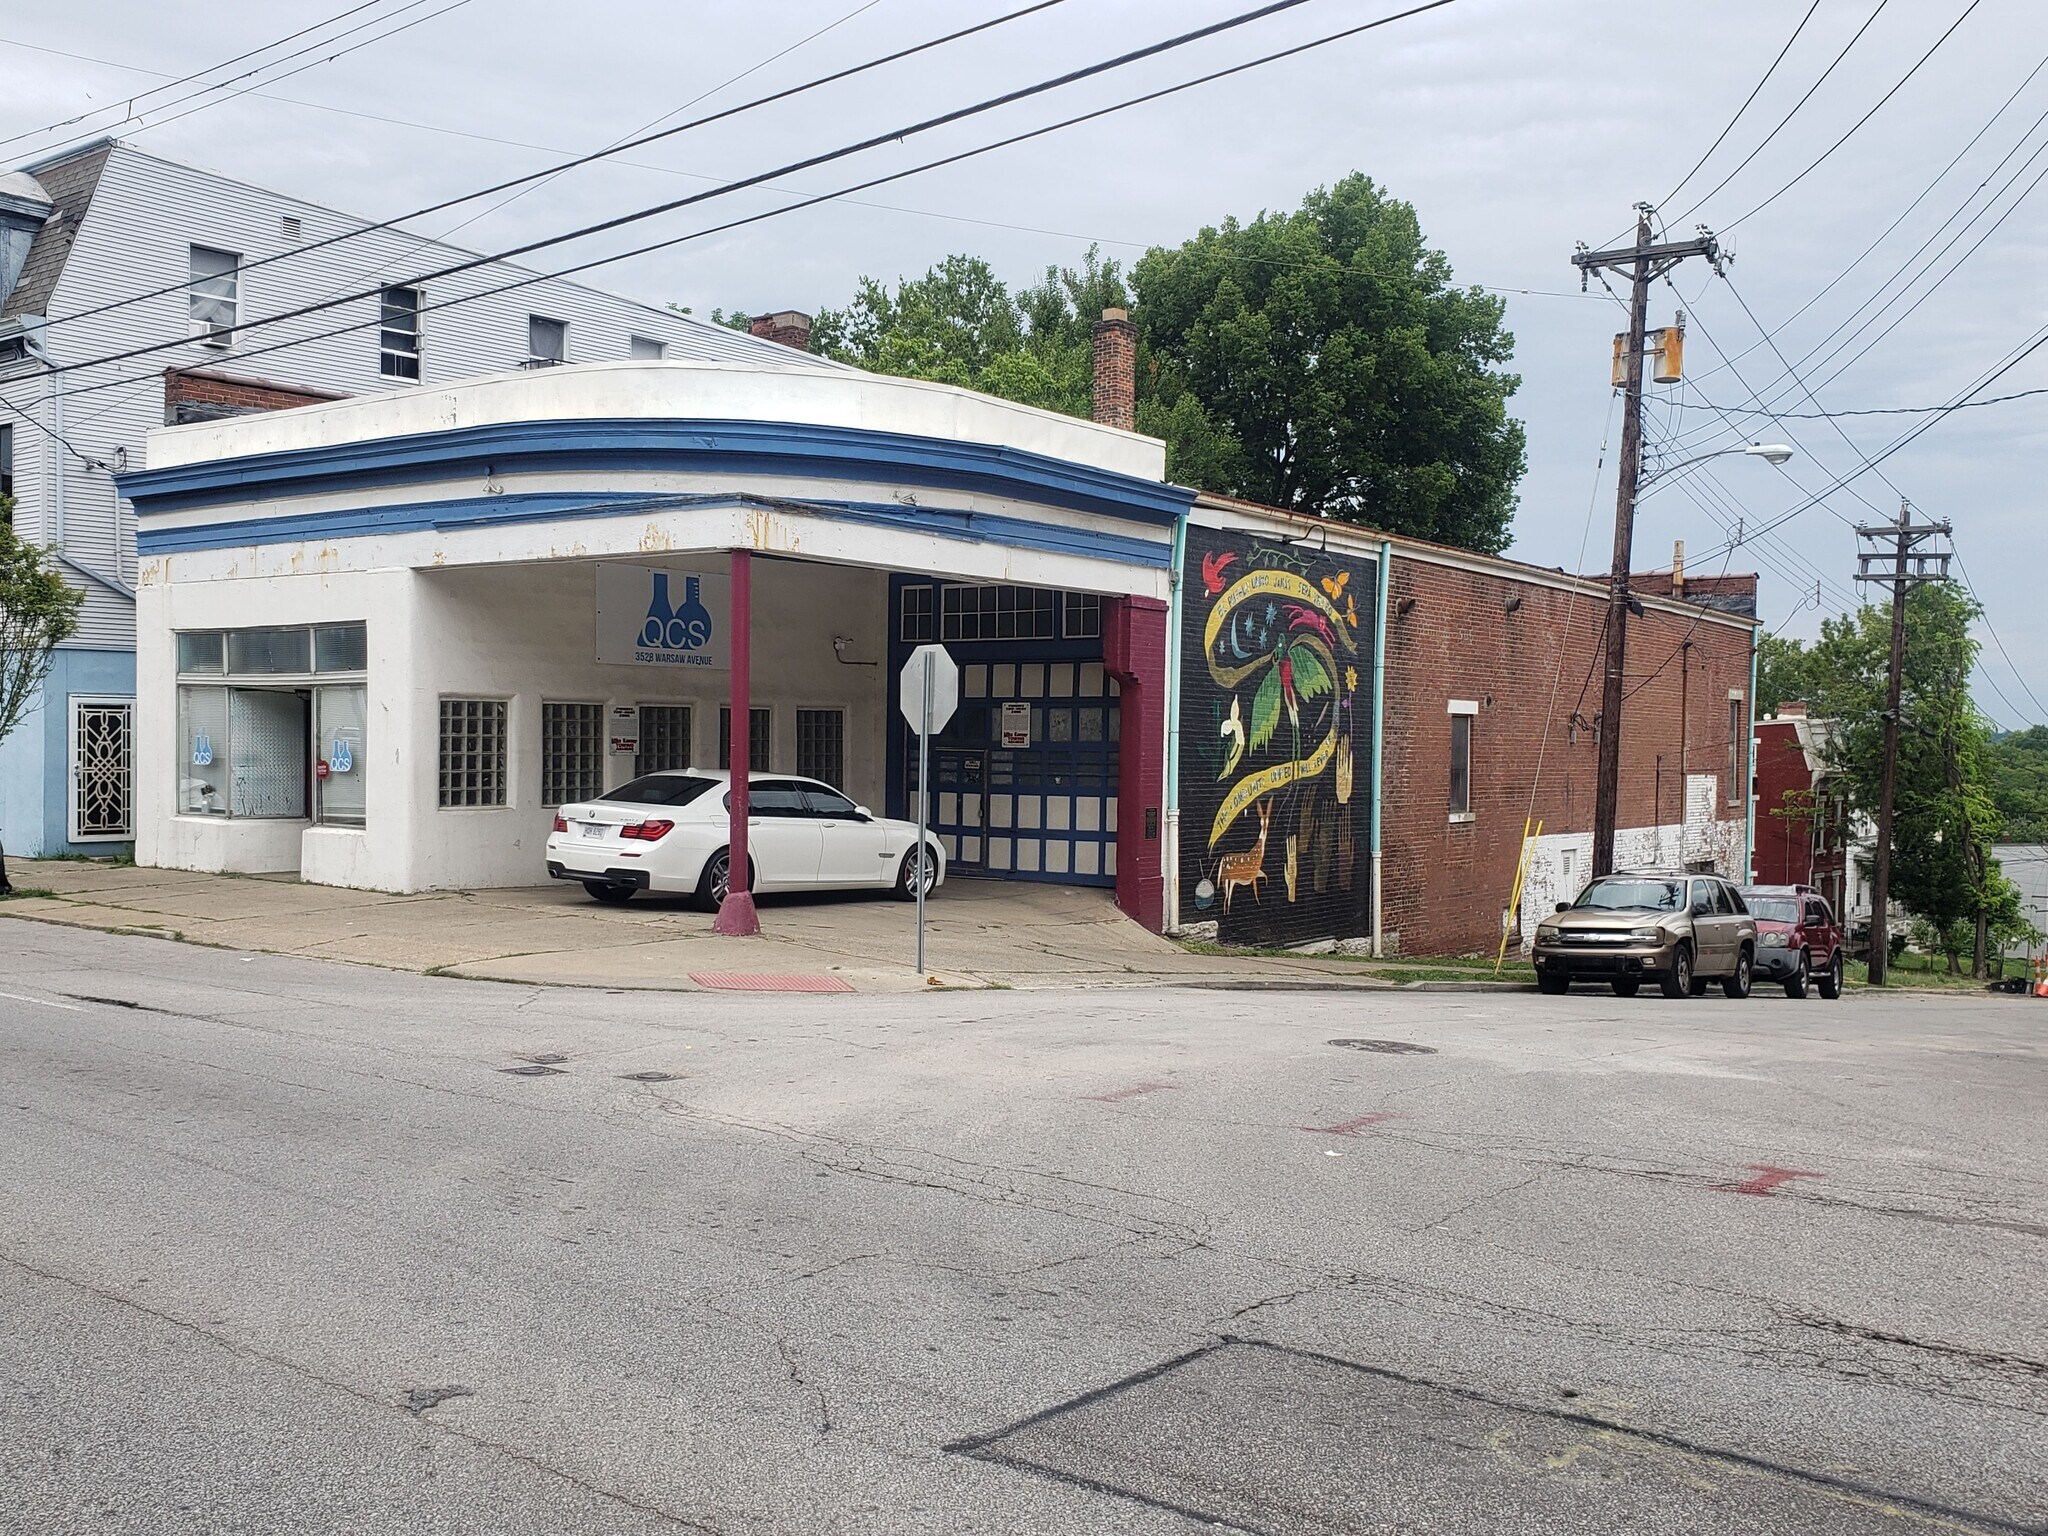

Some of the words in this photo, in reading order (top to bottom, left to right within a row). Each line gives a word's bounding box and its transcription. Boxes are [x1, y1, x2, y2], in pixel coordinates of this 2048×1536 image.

[642, 617, 706, 649] QCS
[635, 652, 654, 662] 3528
[655, 653, 686, 664] WARSAW
[687, 655, 713, 665] AVENUE
[193, 752, 212, 764] QCS
[330, 757, 351, 771] QCS
